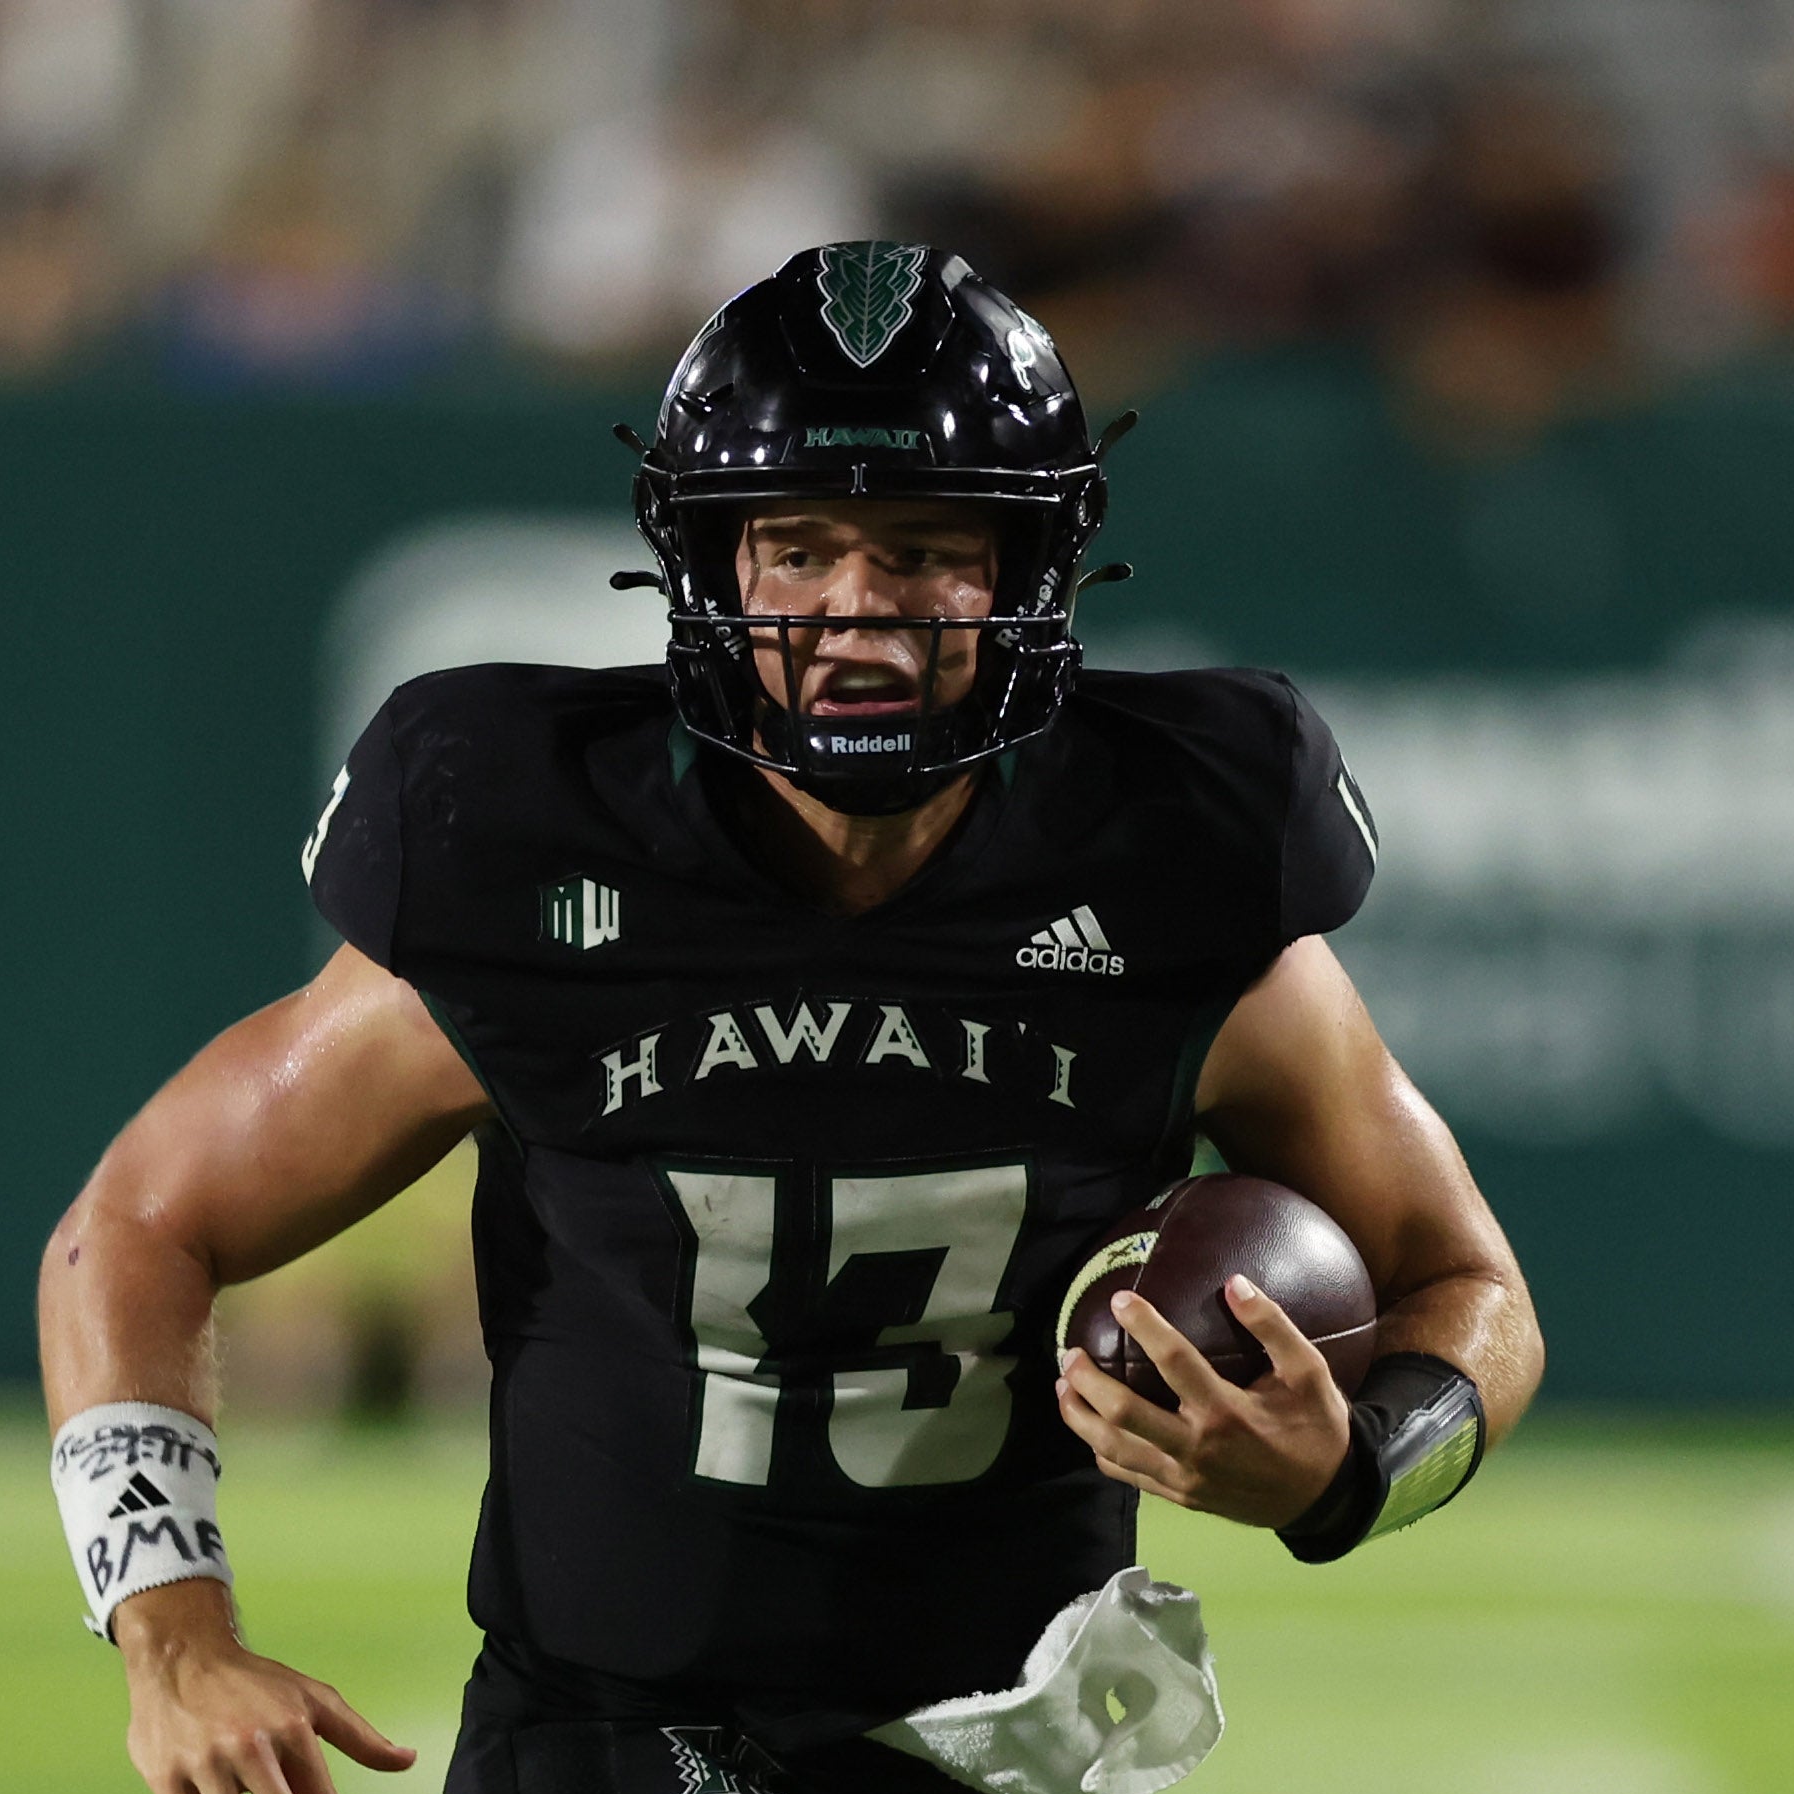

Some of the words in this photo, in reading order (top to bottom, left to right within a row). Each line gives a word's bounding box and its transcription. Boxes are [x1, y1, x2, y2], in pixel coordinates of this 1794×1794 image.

[830, 733, 911, 754] Riddell
[1015, 943, 1126, 977] adidas
[665, 1163, 1029, 1489] 13
